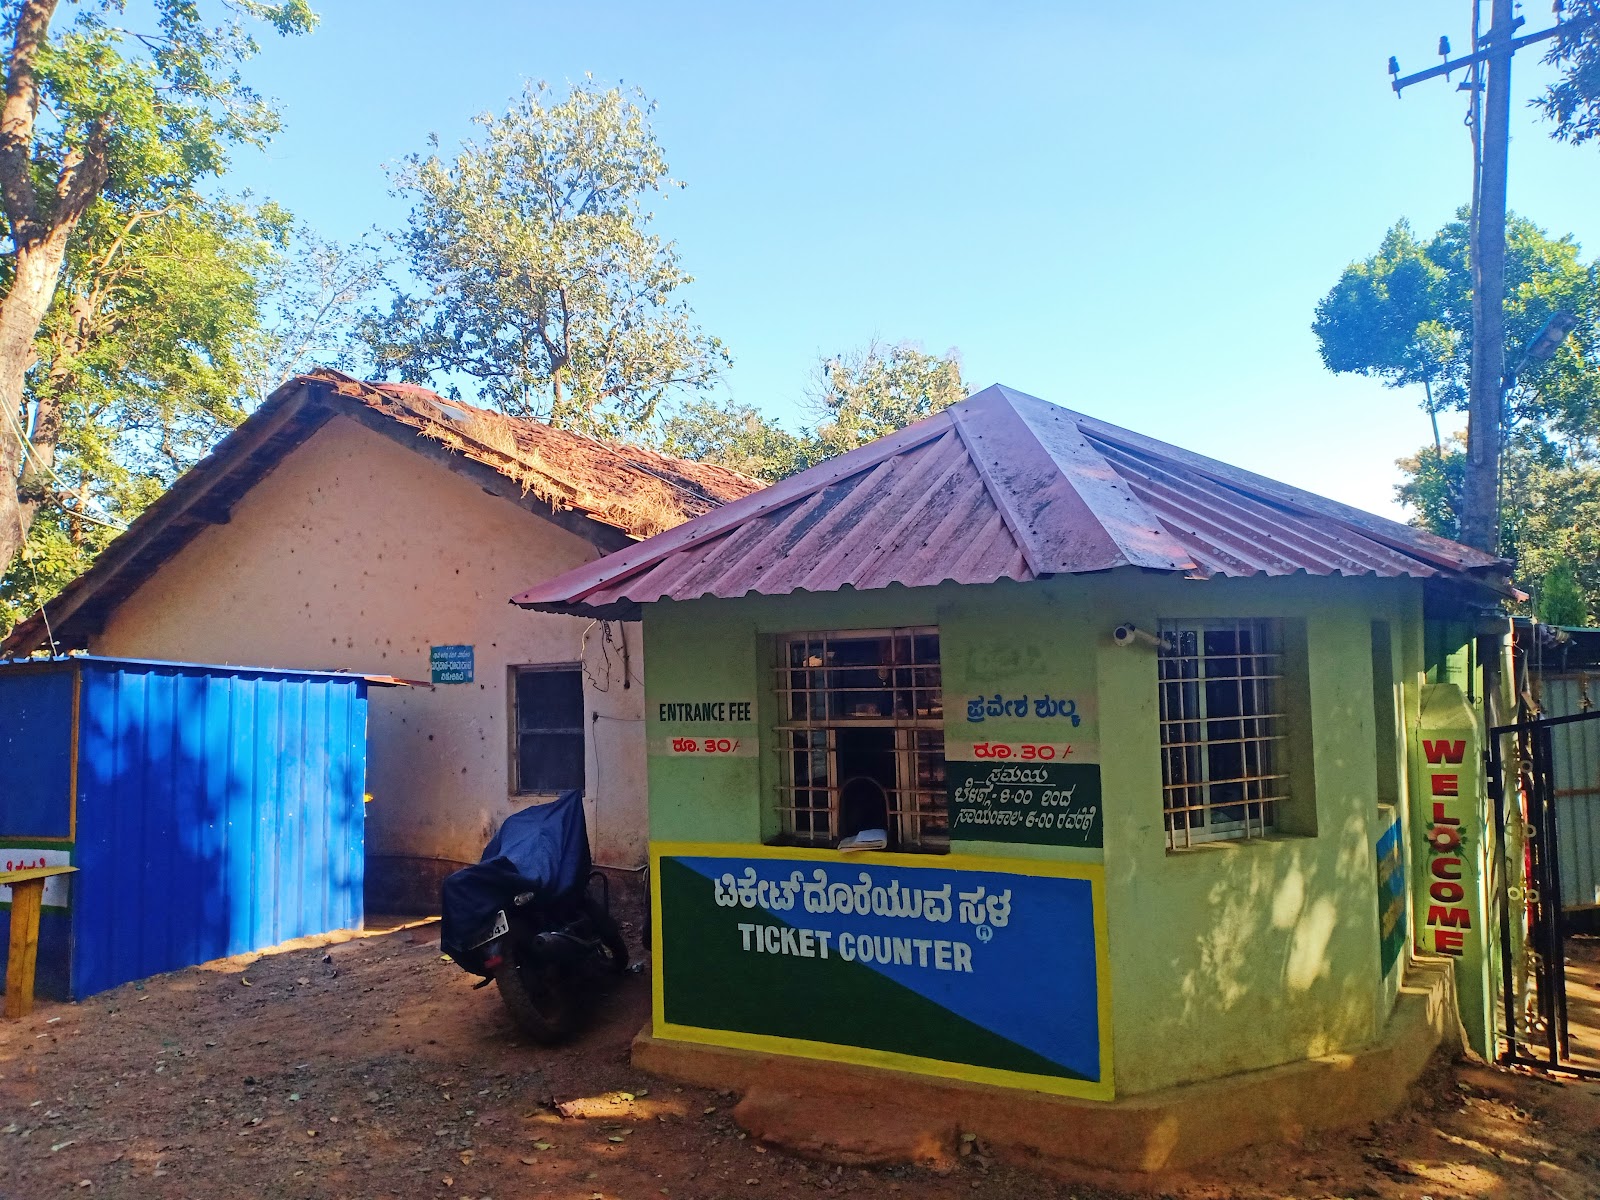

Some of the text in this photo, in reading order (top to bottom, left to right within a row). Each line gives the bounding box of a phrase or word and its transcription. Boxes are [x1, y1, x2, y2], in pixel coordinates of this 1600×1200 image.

[659, 702, 751, 722] ENTRANCE FEE
[966, 693, 1081, 728] ಪ್ರವೇಶ ಶುಲ್ಕ
[985, 764, 1049, 785] ಸಮಯ
[1421, 739, 1472, 957] WELCOME
[958, 885, 1013, 944] ಸ್ಥಳ
[737, 922, 974, 974] TICKET COUNTER
